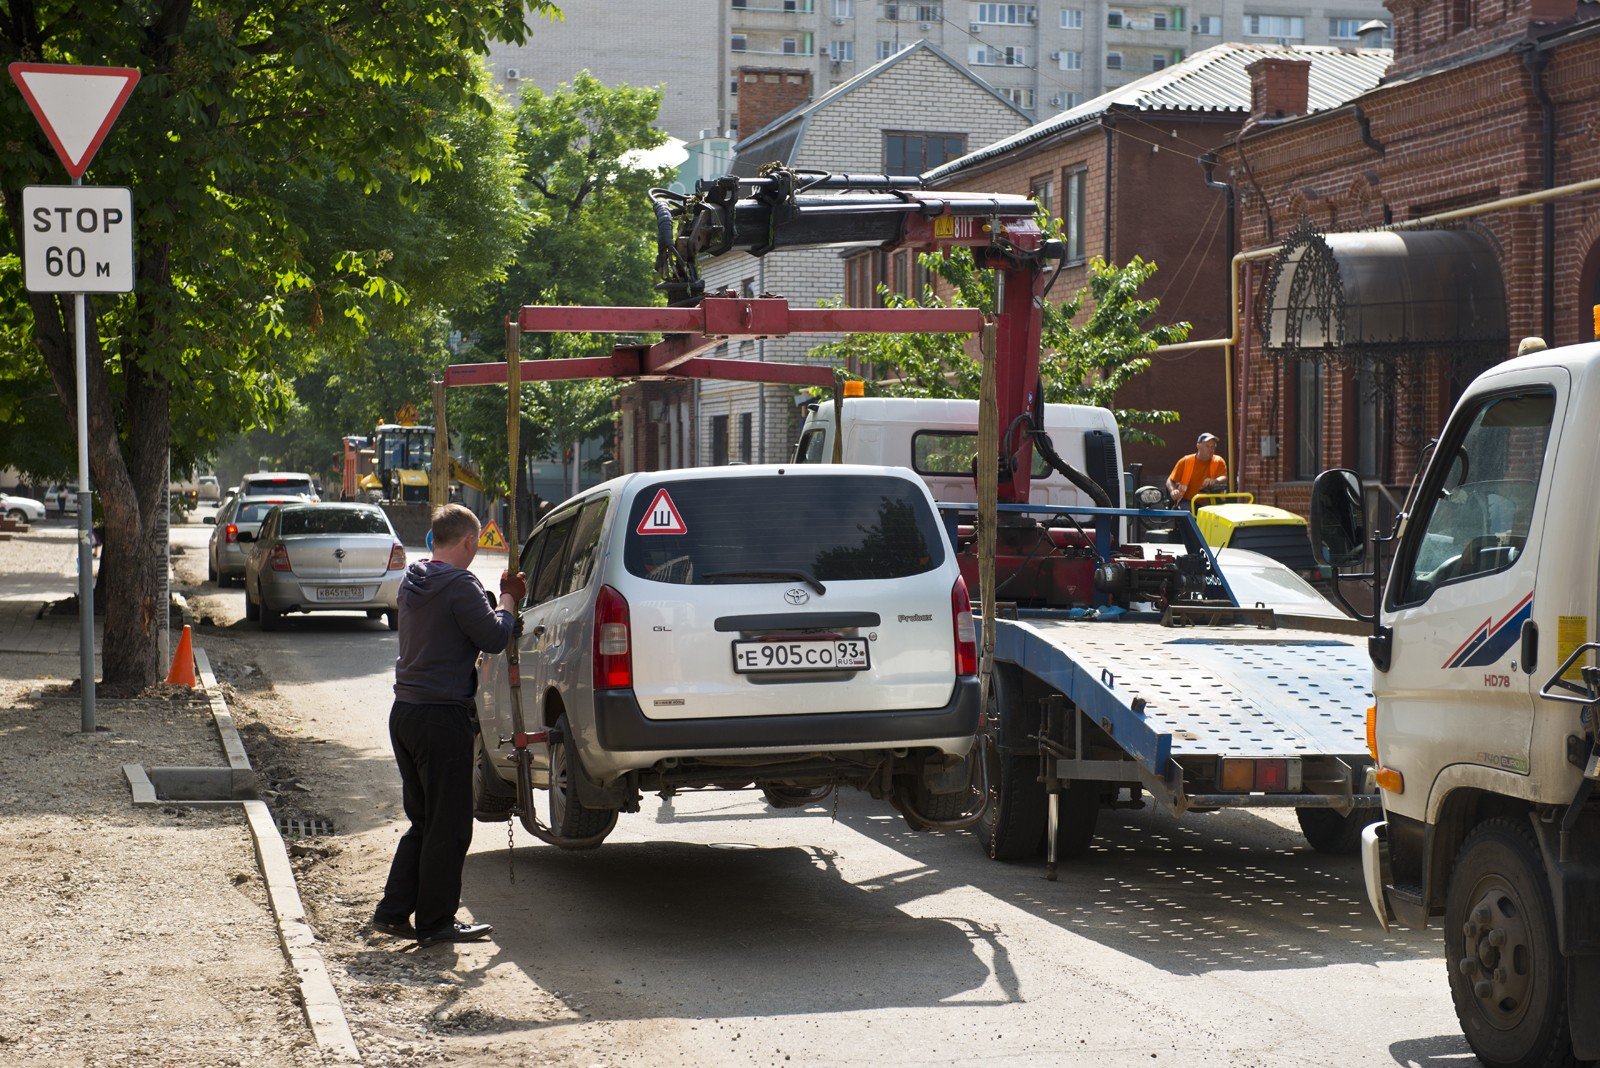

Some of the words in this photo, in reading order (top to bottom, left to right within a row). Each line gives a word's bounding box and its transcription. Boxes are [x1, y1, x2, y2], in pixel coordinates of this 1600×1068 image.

[33, 207, 123, 234] STOP
[46, 246, 86, 278] 60
[653, 511, 670, 527] Ш
[745, 645, 833, 667] Е905СО
[837, 643, 859, 658] 93
[1484, 674, 1511, 688] HD78
